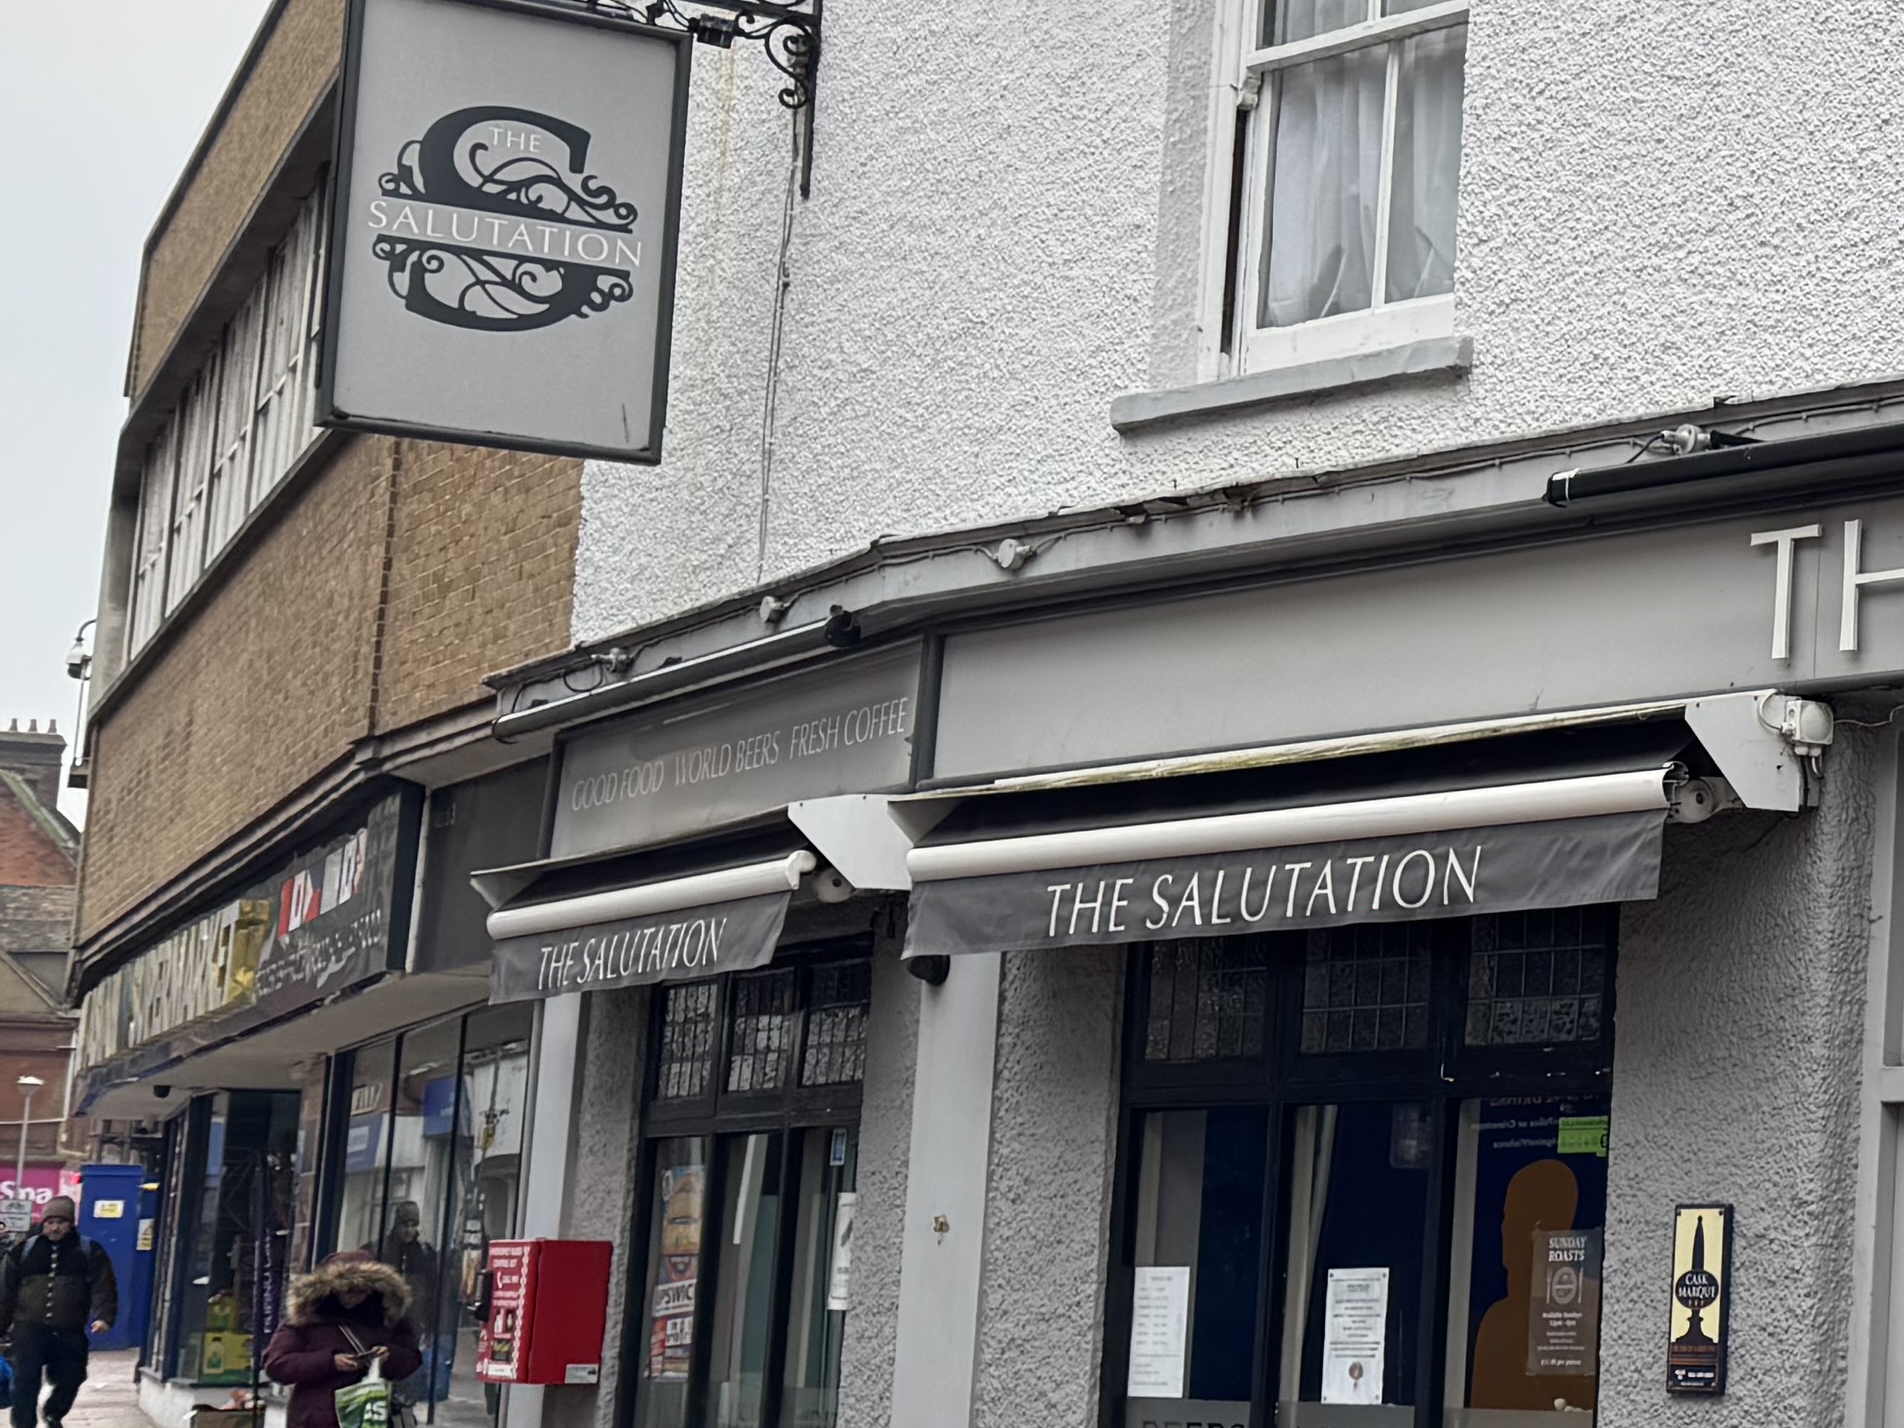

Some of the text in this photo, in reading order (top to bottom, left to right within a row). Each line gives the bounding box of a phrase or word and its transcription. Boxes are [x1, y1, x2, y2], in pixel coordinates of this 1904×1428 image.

[489, 127, 542, 155] THE
[368, 200, 643, 267] SALUTATION
[572, 697, 908, 812] GOOD FOOD WORLD BEERS FRESH COFFEE
[1046, 845, 1482, 938] THE SALUTATION
[538, 917, 727, 991] THE SALUTATION
[1548, 1236, 1587, 1249] SUNDAY
[1548, 1250, 1585, 1262] ROASTS
[1685, 1273, 1708, 1285] CASK
